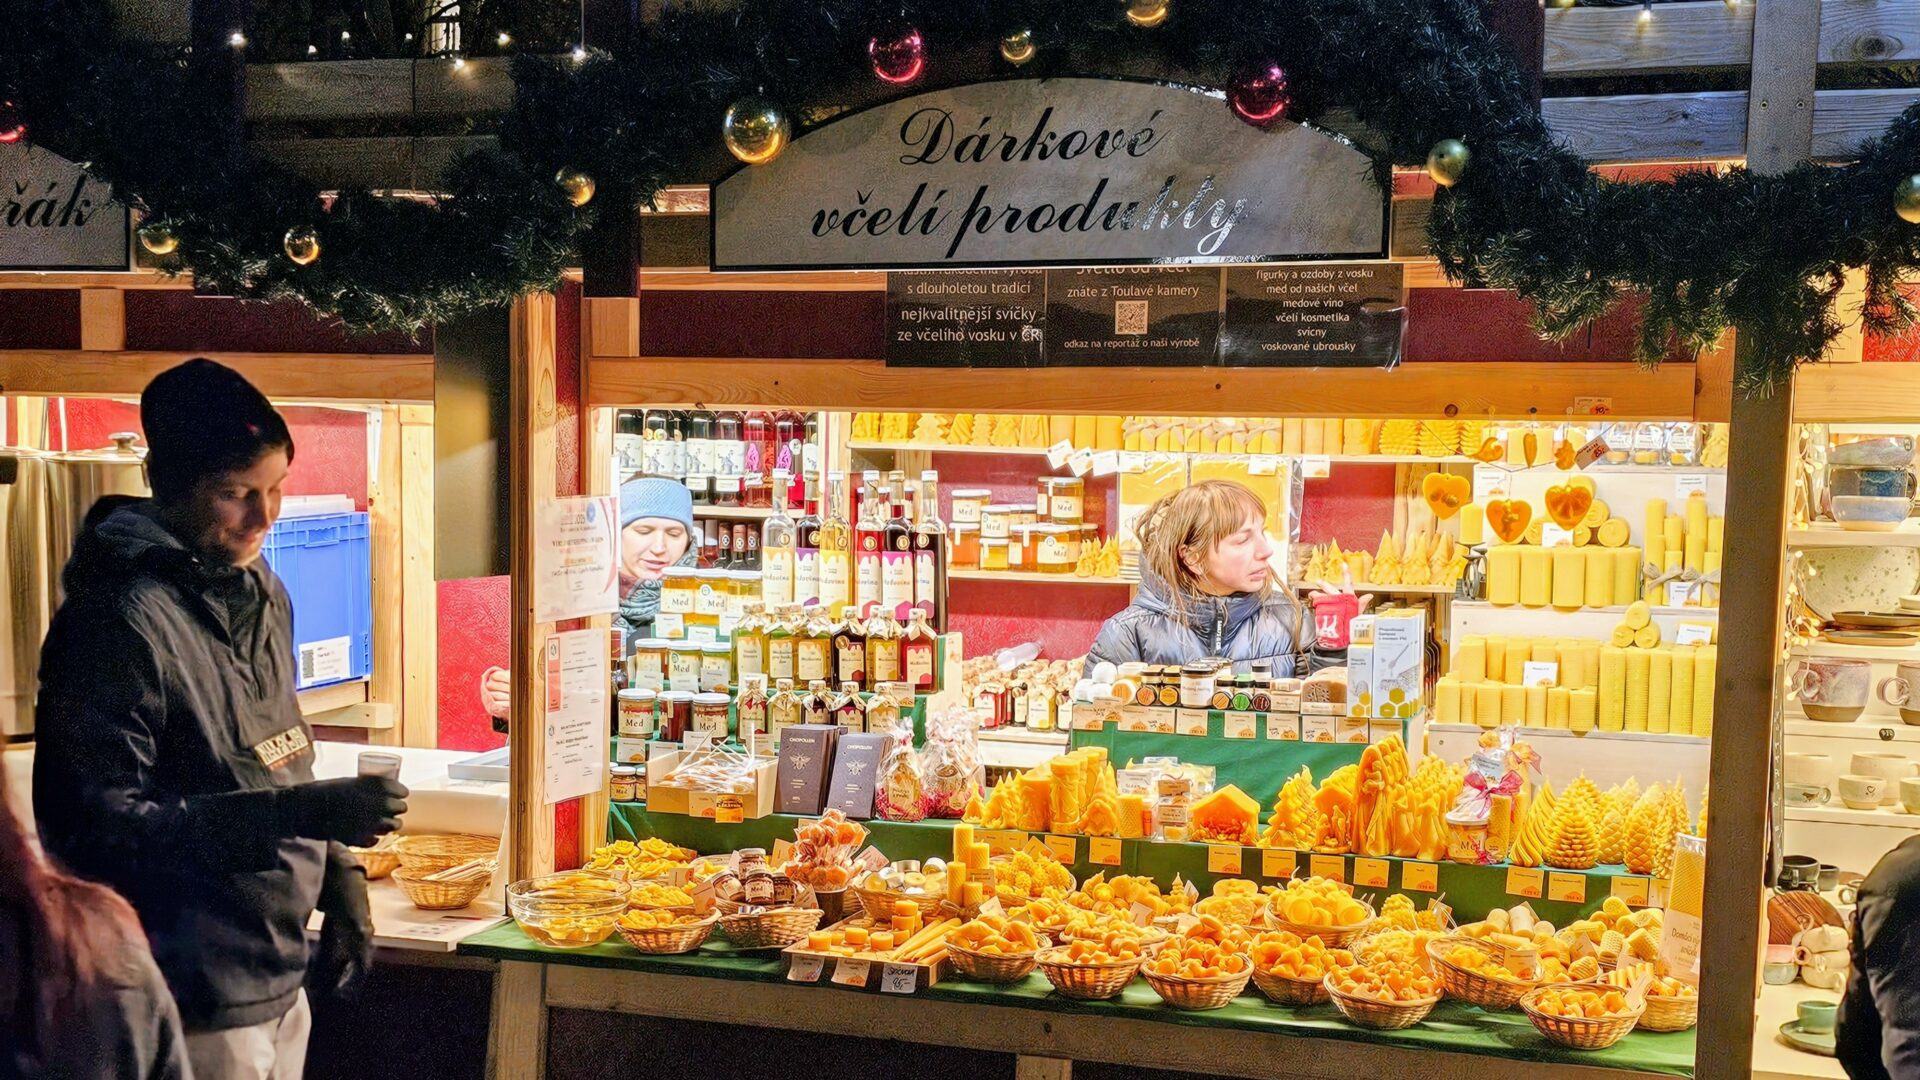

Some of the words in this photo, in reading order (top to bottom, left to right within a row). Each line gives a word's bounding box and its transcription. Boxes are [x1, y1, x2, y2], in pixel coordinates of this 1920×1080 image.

[899, 107, 1162, 167] Dárkové
[811, 177, 948, 238] včelí
[945, 177, 1250, 258] produkty
[1256, 270, 1289, 281] figurky
[1301, 269, 1334, 281] ozdoby
[1346, 269, 1374, 278] vosku
[907, 285, 913, 294] s
[916, 282, 987, 294] dlouholetou
[991, 281, 1031, 294] tradicí
[1067, 286, 1098, 298] znáte
[1101, 288, 1107, 297] z
[1111, 284, 1154, 297] Toulavé
[1157, 285, 1200, 298] kamery
[1266, 284, 1287, 293] med
[1290, 284, 1302, 293] od
[1338, 283, 1358, 292] včel
[1283, 298, 1320, 308] medové
[901, 306, 992, 323] nejkvalitnější
[996, 305, 1037, 323] svíčky
[1301, 312, 1350, 322] kosmetika
[897, 331, 912, 341] ze
[917, 328, 965, 341] včelího
[968, 328, 1005, 341] vosku
[1010, 331, 1017, 341] v
[1021, 325, 1041, 342] ČR
[1064, 339, 1089, 348] odkaz
[1104, 338, 1140, 349] reportáž
[1170, 337, 1200, 349] výrobě
[1261, 341, 1310, 351] voskované
[1313, 342, 1356, 352] ubrousky
[958, 508, 973, 516] Med
[1057, 504, 1073, 512] Med
[985, 523, 1000, 531] Med
[672, 598, 689, 606] Med
[708, 600, 724, 608] Med
[673, 664, 690, 673] Med
[625, 719, 644, 728] Med
[700, 722, 717, 731] Med
